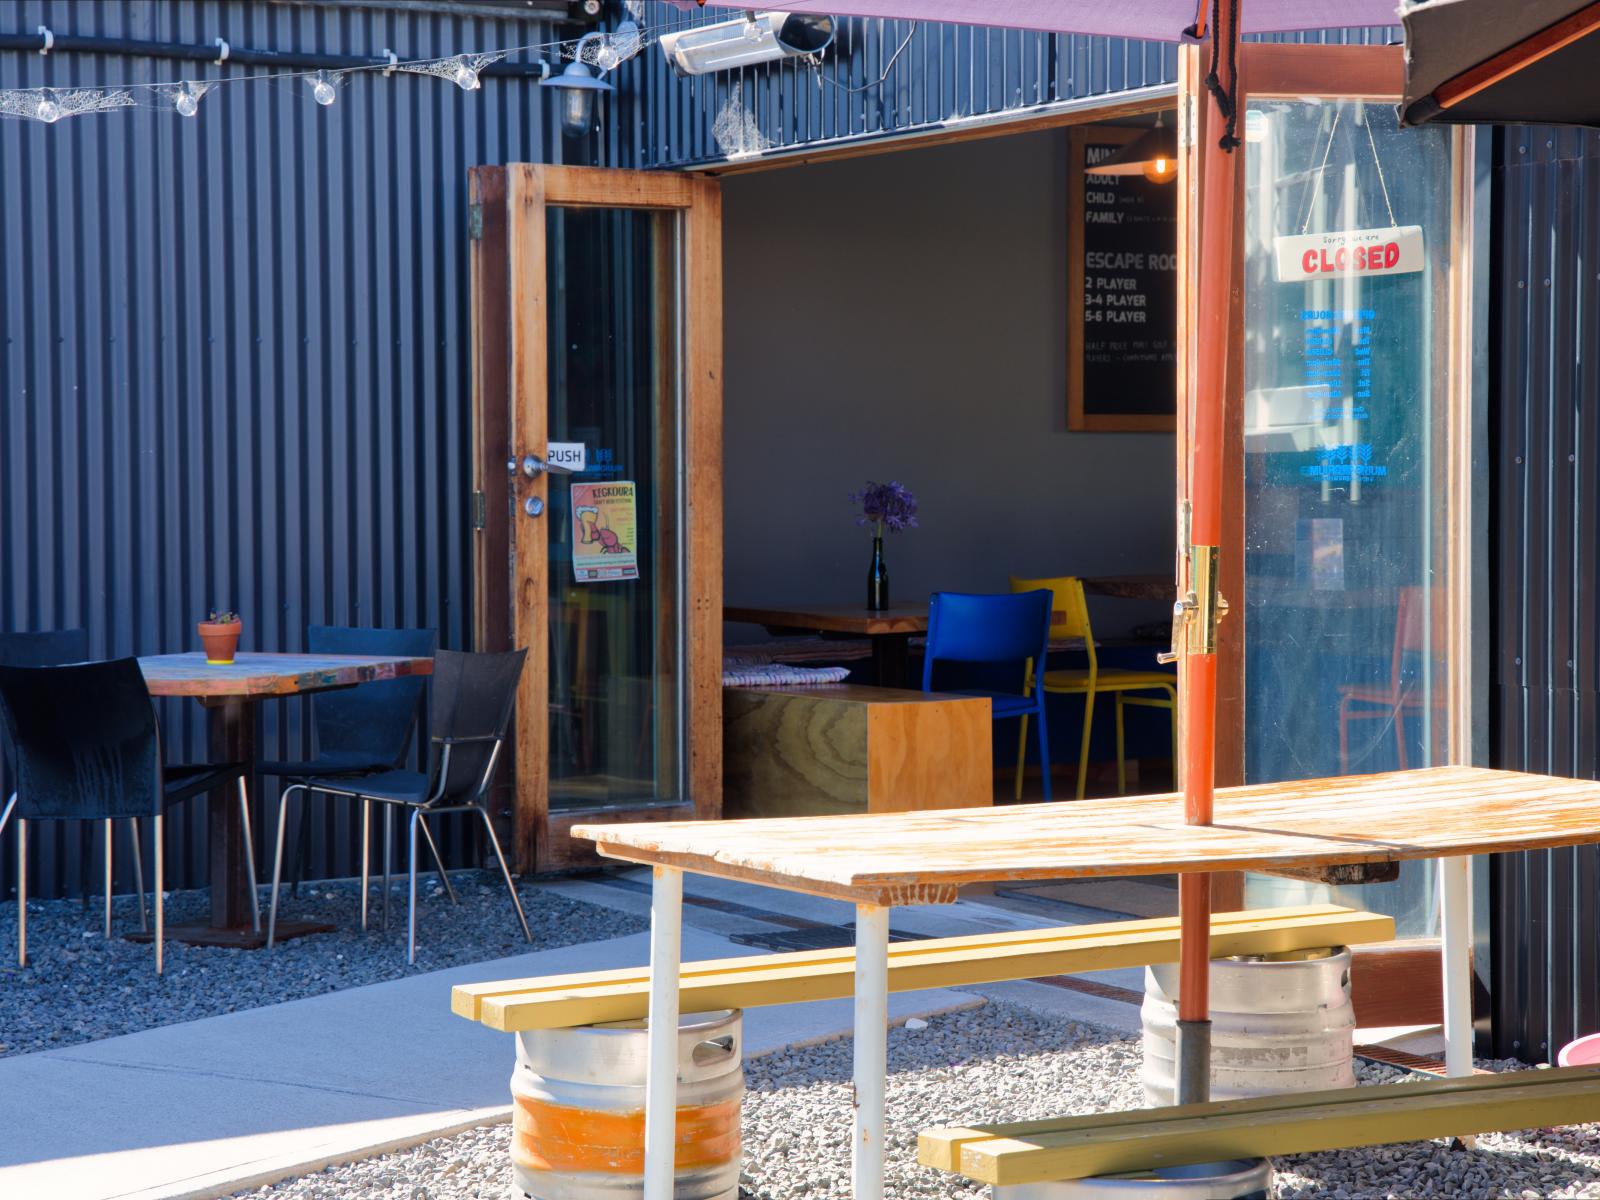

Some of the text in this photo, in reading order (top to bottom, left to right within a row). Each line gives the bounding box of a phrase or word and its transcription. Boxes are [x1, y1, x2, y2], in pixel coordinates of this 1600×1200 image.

[1086, 192, 1115, 203] CHILD
[1086, 211, 1124, 223] FAMILY
[1086, 252, 1144, 269] ESCAPE
[1302, 242, 1399, 273] CLOSED
[1085, 277, 1136, 290] 2 PLAYER
[1085, 294, 1146, 306] 3-4 PLAYER
[1085, 310, 1146, 323] 5-6 PLAYER
[548, 450, 581, 462] PUSH
